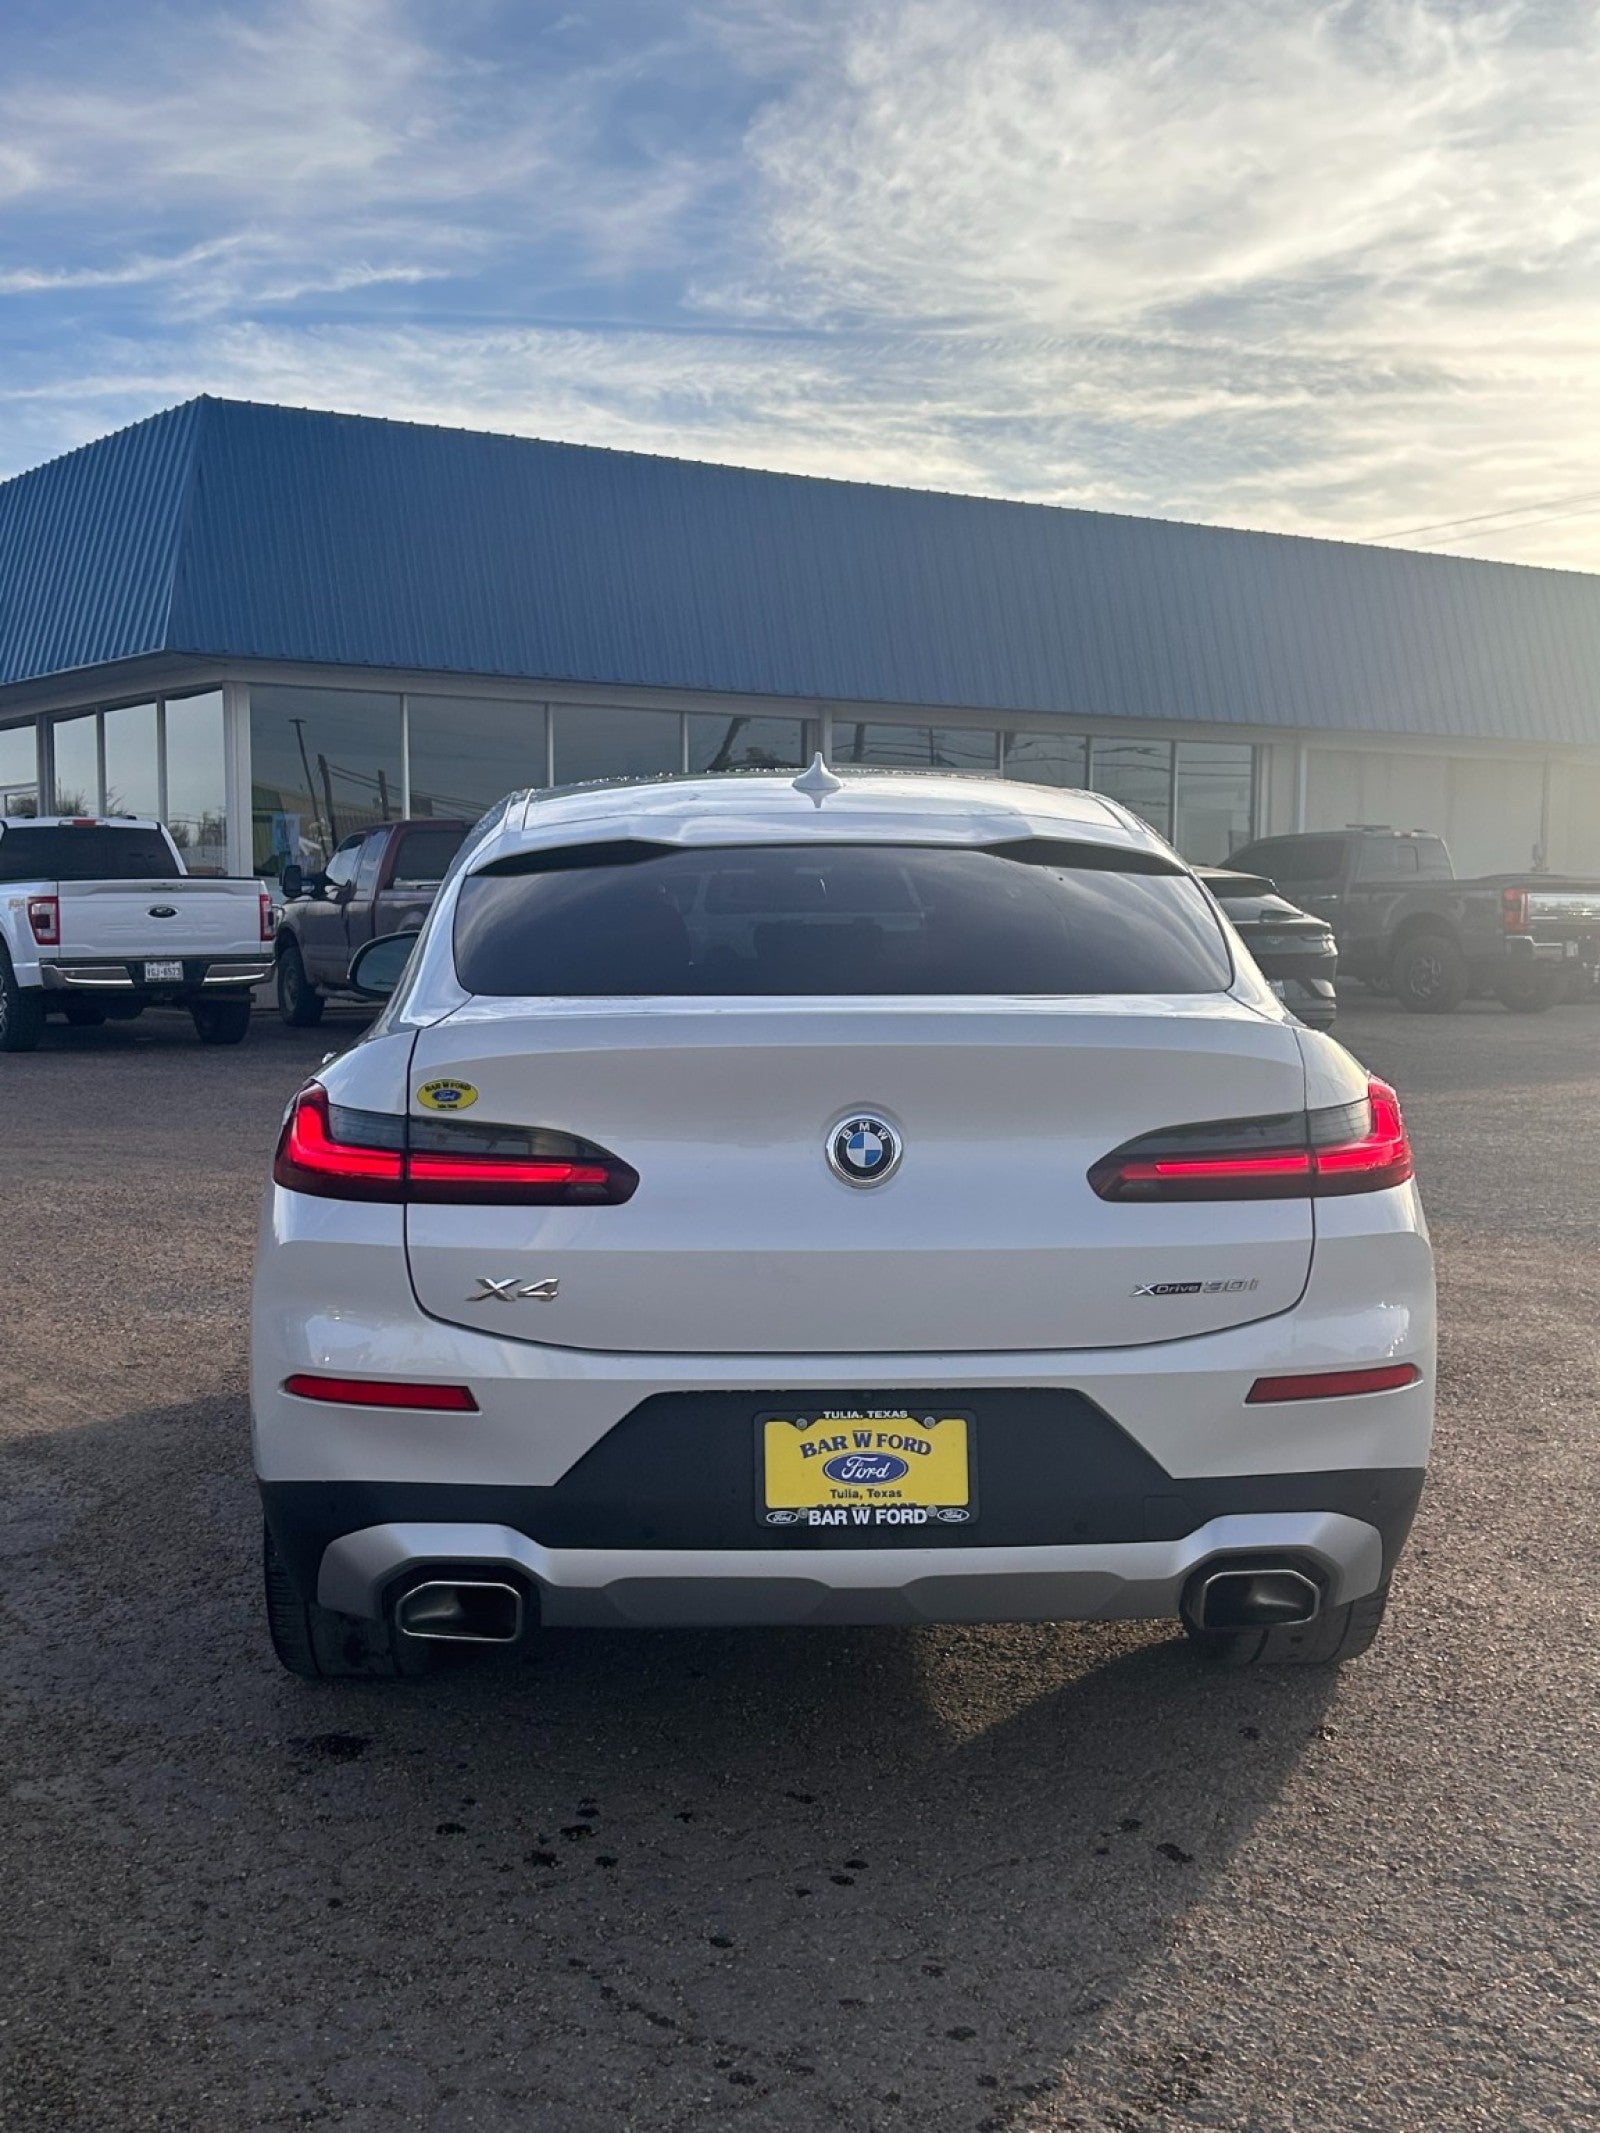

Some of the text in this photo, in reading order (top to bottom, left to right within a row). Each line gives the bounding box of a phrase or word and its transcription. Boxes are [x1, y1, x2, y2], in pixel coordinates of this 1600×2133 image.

[842, 1122, 889, 1140] BMW
[464, 1279, 559, 1301] X4
[867, 1410, 908, 1418] TEXAS
[800, 1430, 932, 1458] BAR W FORD
[841, 1455, 890, 1480] Ford
[830, 1488, 902, 1500] Tulia, Texas
[808, 1507, 928, 1526] BAR W FORD
